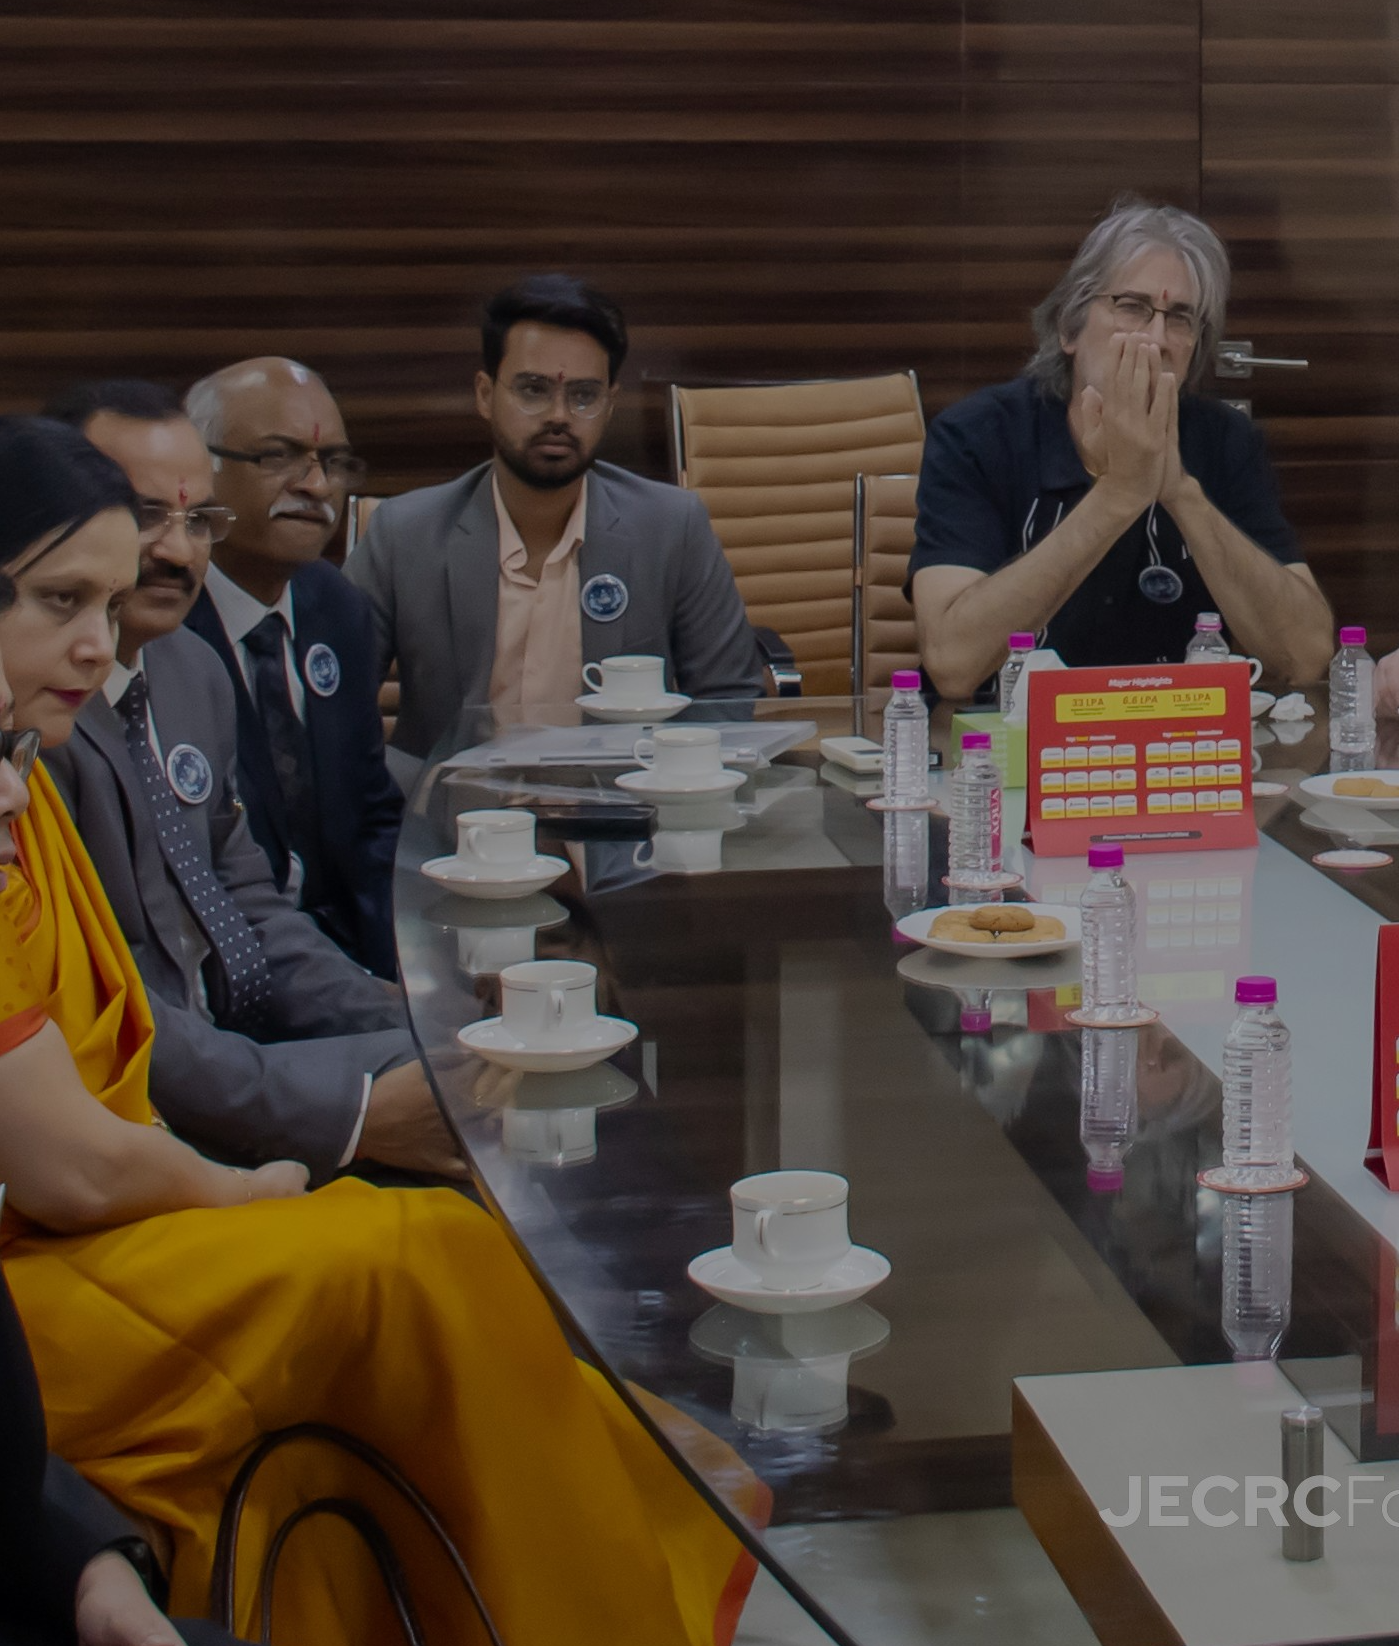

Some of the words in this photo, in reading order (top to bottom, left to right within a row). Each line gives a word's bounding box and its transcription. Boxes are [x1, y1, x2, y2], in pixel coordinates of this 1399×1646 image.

[1072, 698, 1086, 707] 33
[1086, 698, 1104, 707] LPA
[1140, 695, 1159, 704] LPA
[1172, 694, 1191, 703] 13.5
[1193, 693, 1212, 702] LPA
